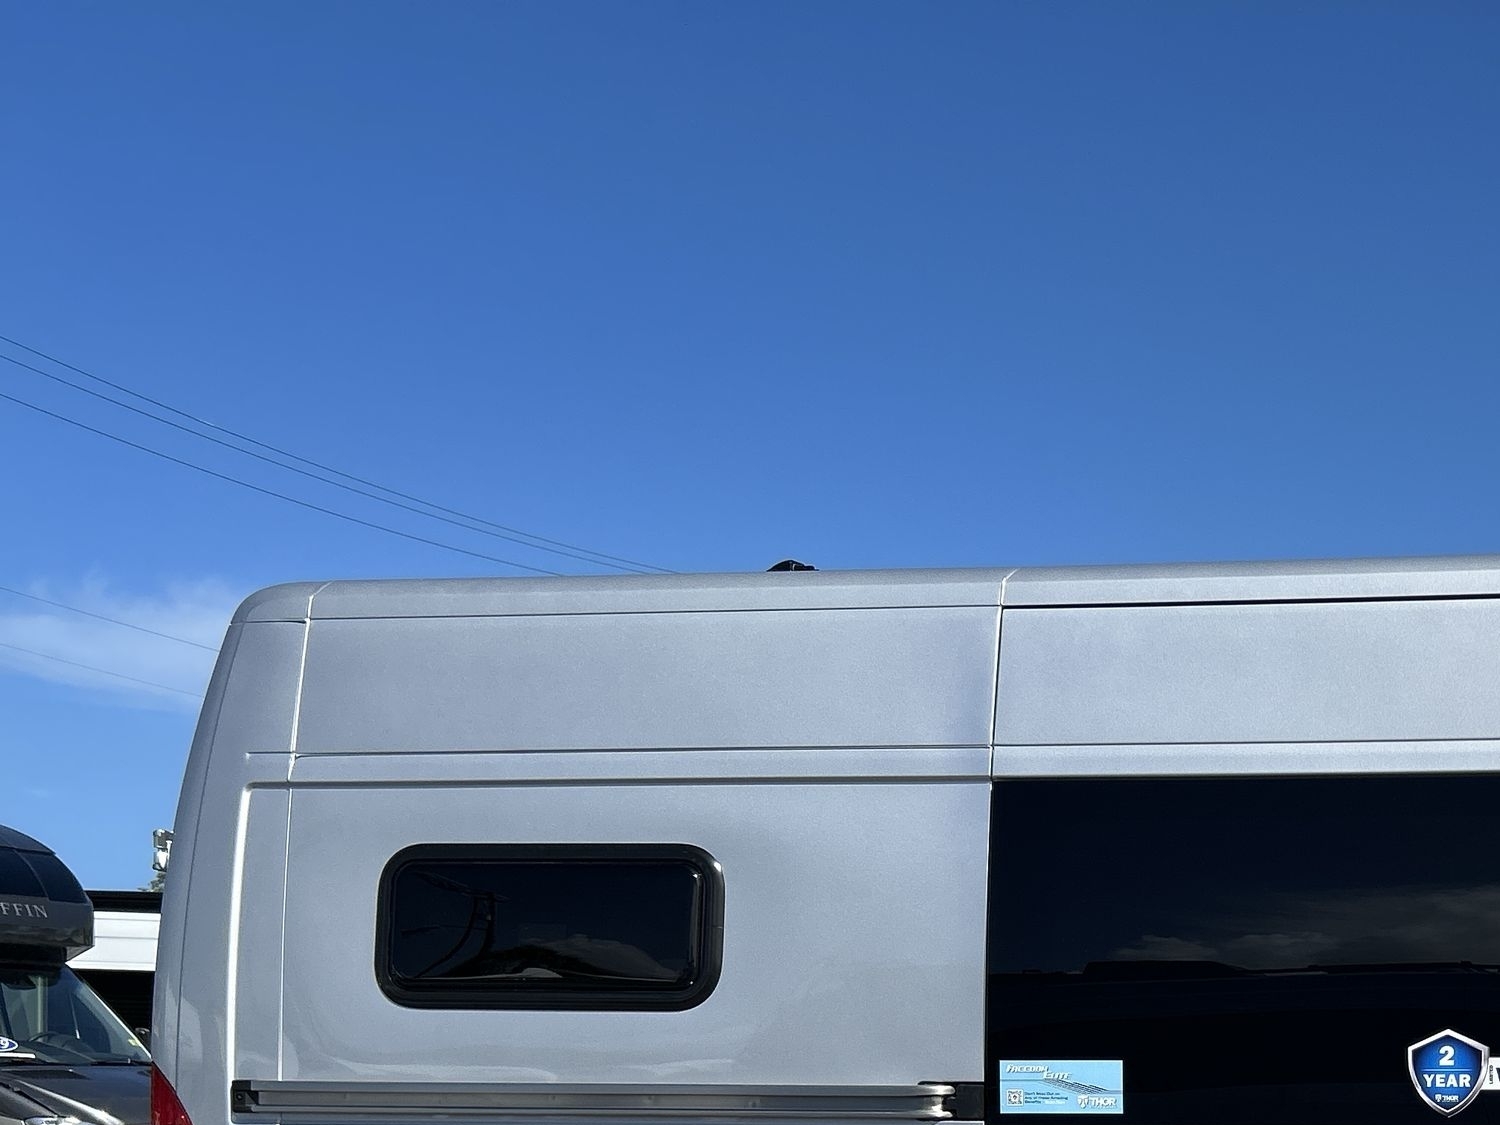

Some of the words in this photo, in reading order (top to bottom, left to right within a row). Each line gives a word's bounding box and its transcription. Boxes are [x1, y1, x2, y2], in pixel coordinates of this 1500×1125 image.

[1439, 1045, 1455, 1066] 2
[1423, 1073, 1471, 1087] YEAR
[1090, 1097, 1117, 1107] THOR
